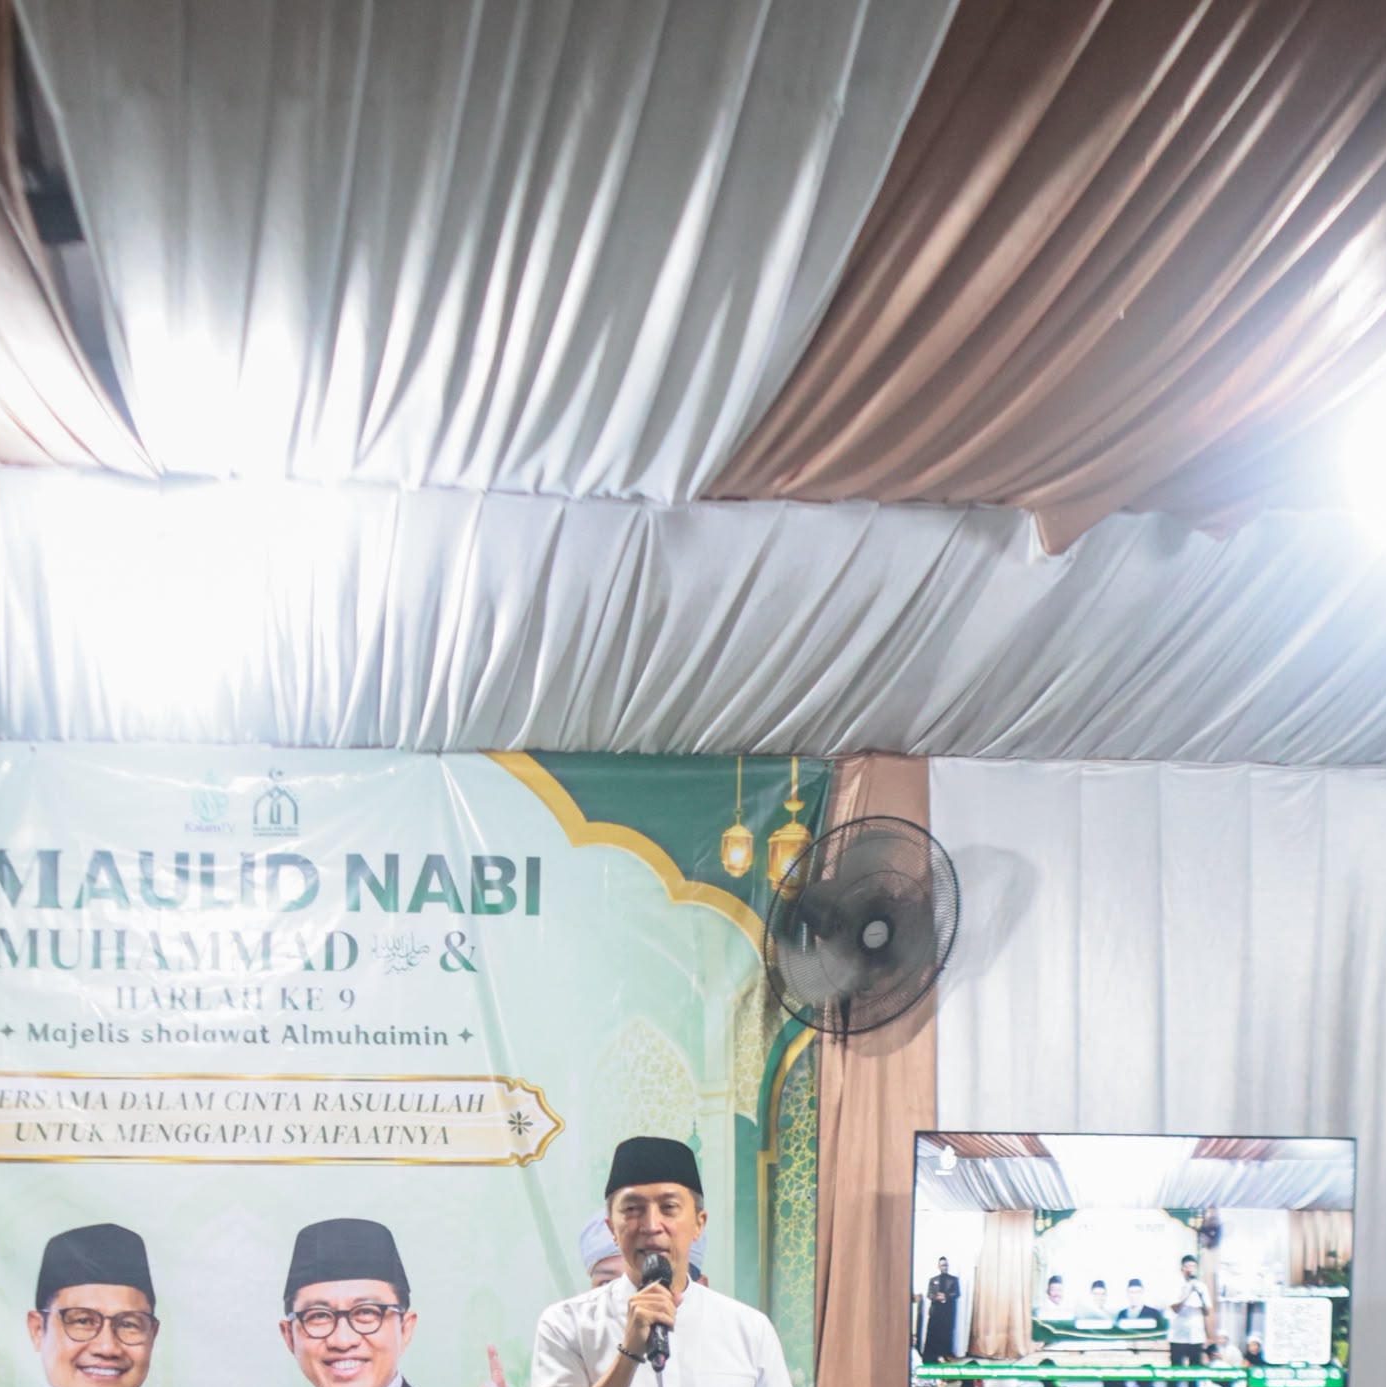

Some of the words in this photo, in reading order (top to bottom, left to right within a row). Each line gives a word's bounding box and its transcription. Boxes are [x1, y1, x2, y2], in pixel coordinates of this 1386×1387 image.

[345, 853, 541, 917] NABI
[438, 930, 479, 974] &
[116, 986, 263, 1010] HARLAH
[280, 987, 324, 1012] KE
[338, 988, 356, 1012] 9
[26, 1023, 130, 1050] Majelis
[141, 1023, 270, 1045] sholawat
[281, 1024, 449, 1047] Almuhaimin
[118, 1090, 215, 1112] DALAM
[224, 1090, 302, 1112] CINTA
[313, 1091, 486, 1114] RASULULLAH
[14, 1121, 105, 1143] UNTUK
[114, 1122, 274, 1145] MENGGAPAI
[281, 1124, 451, 1146] SYAFAATNYA
